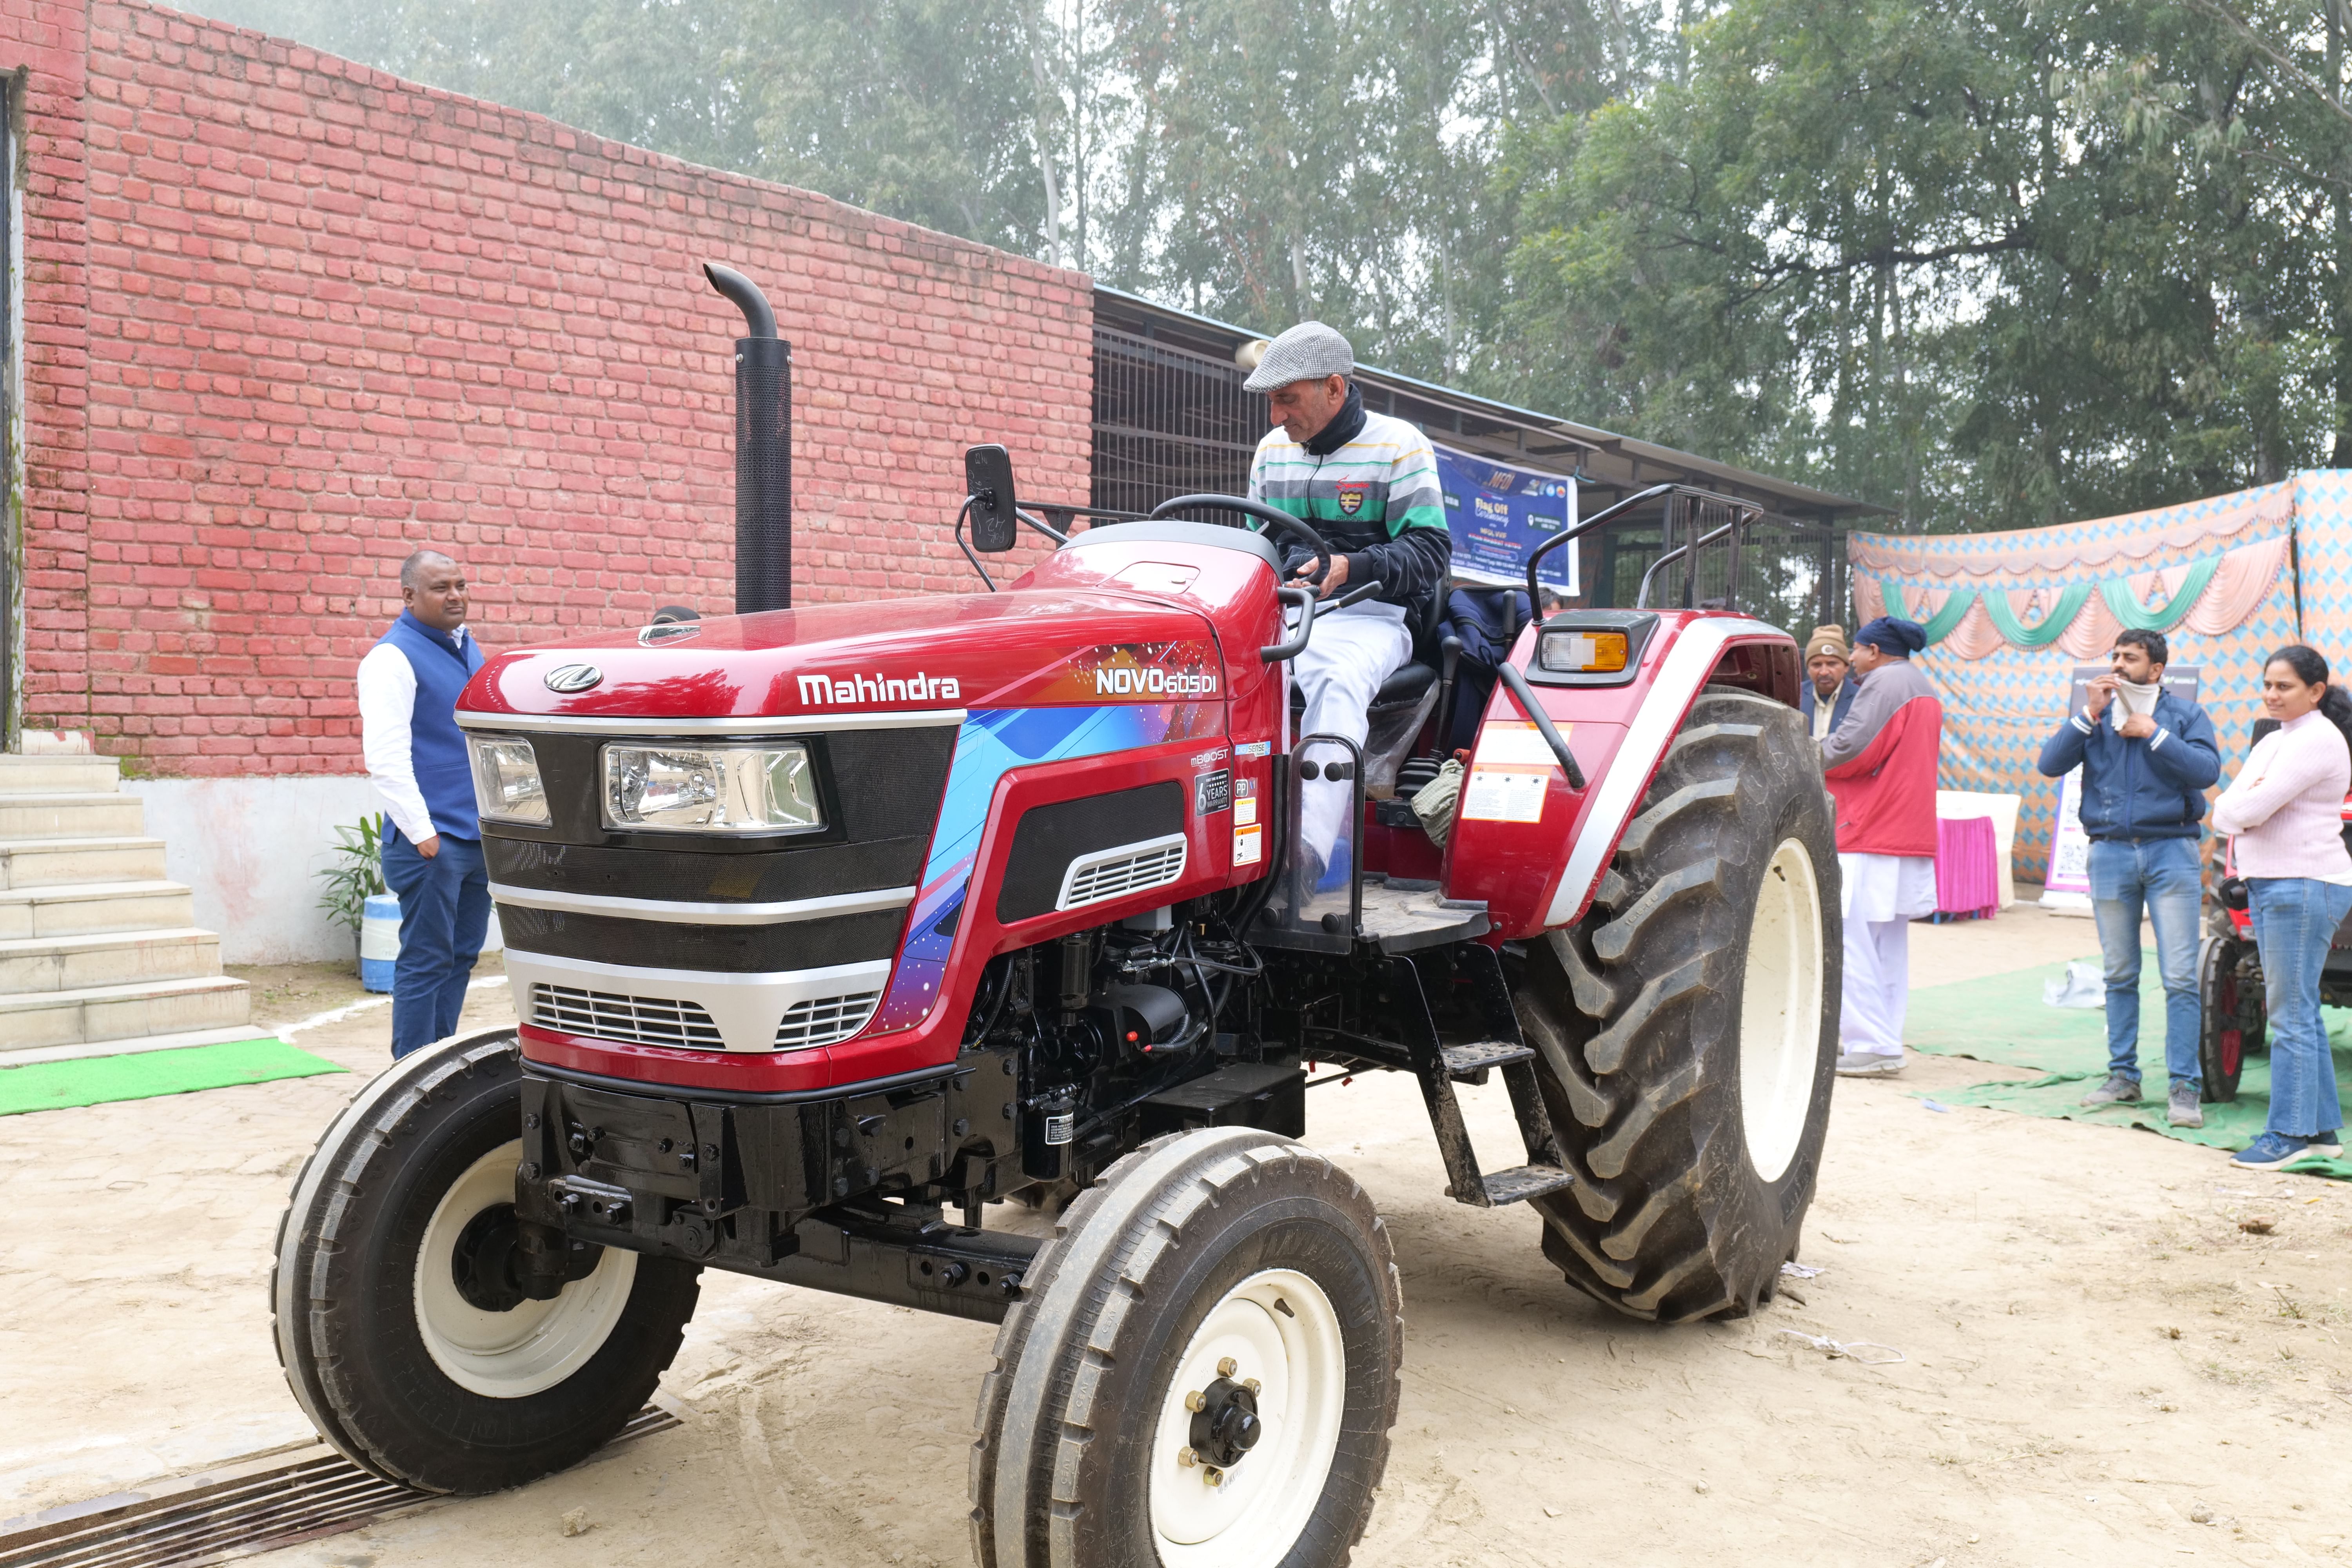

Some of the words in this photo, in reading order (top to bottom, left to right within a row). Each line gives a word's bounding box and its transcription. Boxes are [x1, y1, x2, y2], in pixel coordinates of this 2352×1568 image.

[1475, 497, 1493, 514] Flag
[1494, 503, 1508, 515] Off
[1475, 506, 1509, 527] Ceremony
[797, 671, 960, 705] Mahindra
[1096, 668, 1164, 695] NOVO
[1191, 748, 1229, 766] mBOOST
[1248, 744, 1265, 753] SENSE
[1198, 783, 1207, 811] 6
[1236, 783, 1246, 794] PP
[1207, 797, 1227, 808] WARRANTY
